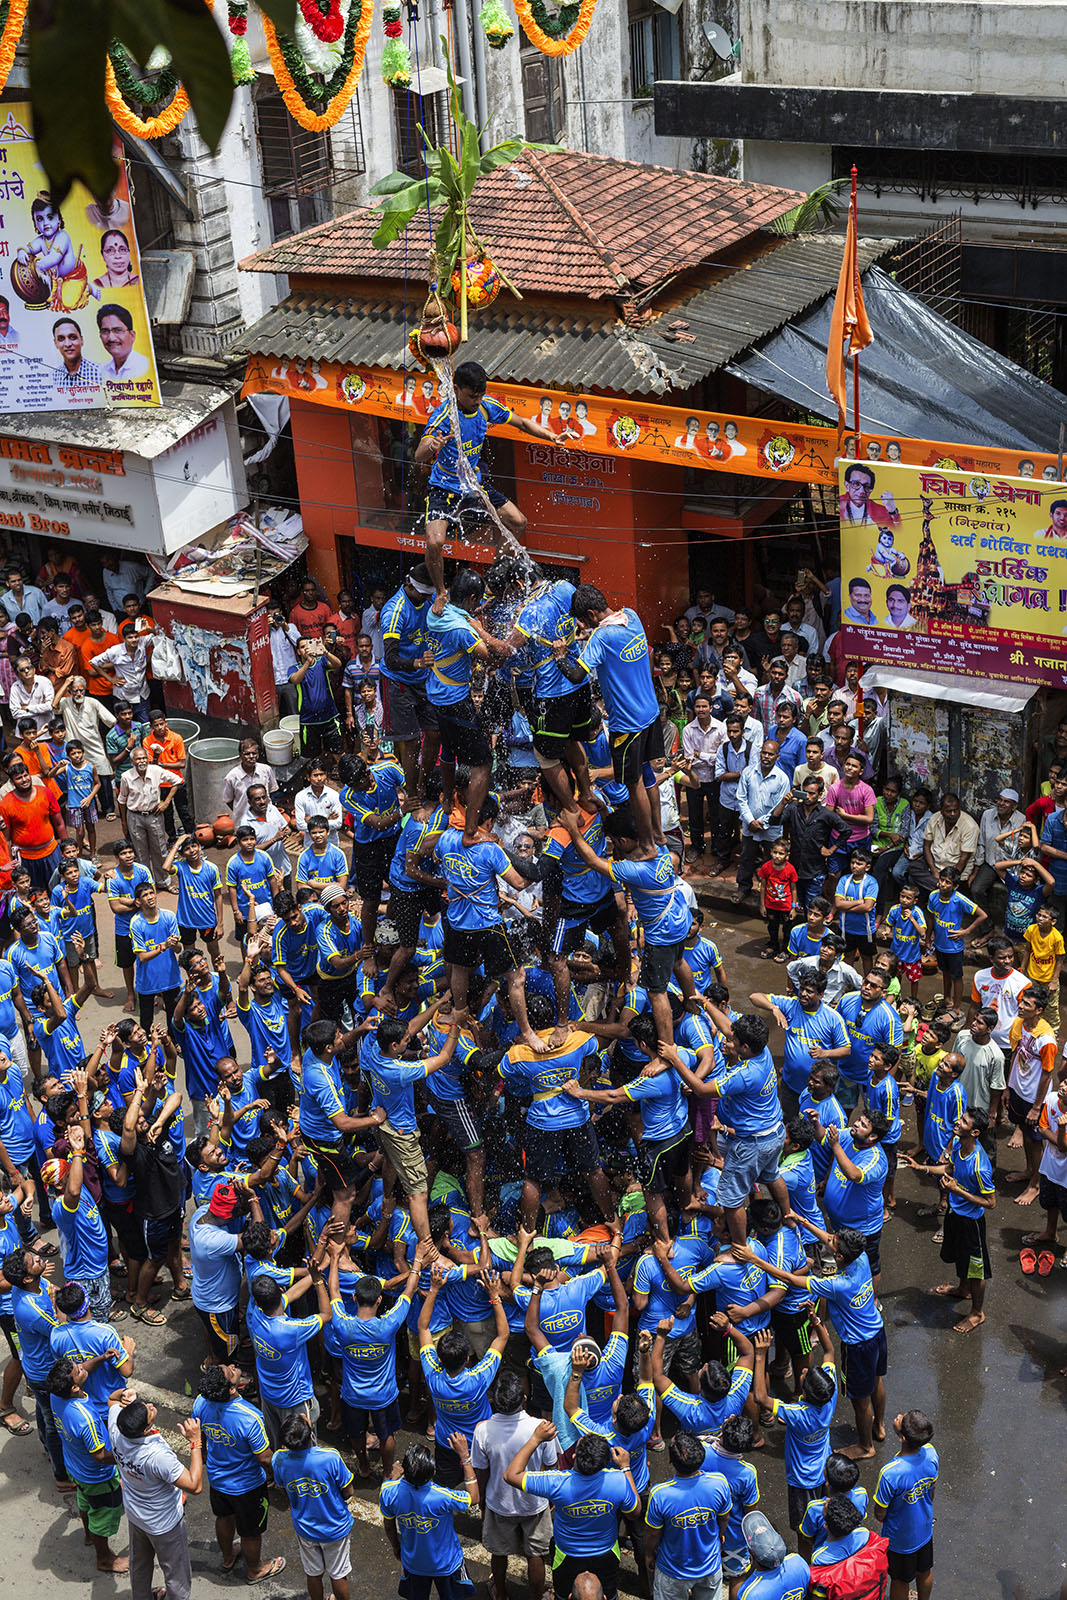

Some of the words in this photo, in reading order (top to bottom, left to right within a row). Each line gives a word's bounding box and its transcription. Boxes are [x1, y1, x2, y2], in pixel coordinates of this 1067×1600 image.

[526, 443, 616, 474] शिवसेना
[919, 473, 967, 497] शिव
[992, 481, 1041, 507] सेना
[103, 502, 131, 521] मिठाई
[944, 501, 971, 512] शाखा
[975, 504, 990, 514] क्र.
[996, 507, 1016, 518] २१५
[28, 513, 70, 535] Bros
[949, 516, 1011, 532] (गिरगांव)
[396, 537, 414, 547] जय
[950, 533, 977, 547] सर्व
[975, 557, 1048, 583] हार्दिक
[972, 581, 1052, 611] स्वागत
[1009, 650, 1029, 666] श्री.
[542, 1312, 579, 1331] ताडदेव
[348, 1344, 386, 1358] ताडदेव
[568, 1500, 607, 1516] ताडदेव
[675, 1508, 710, 1527] ताडदेव
